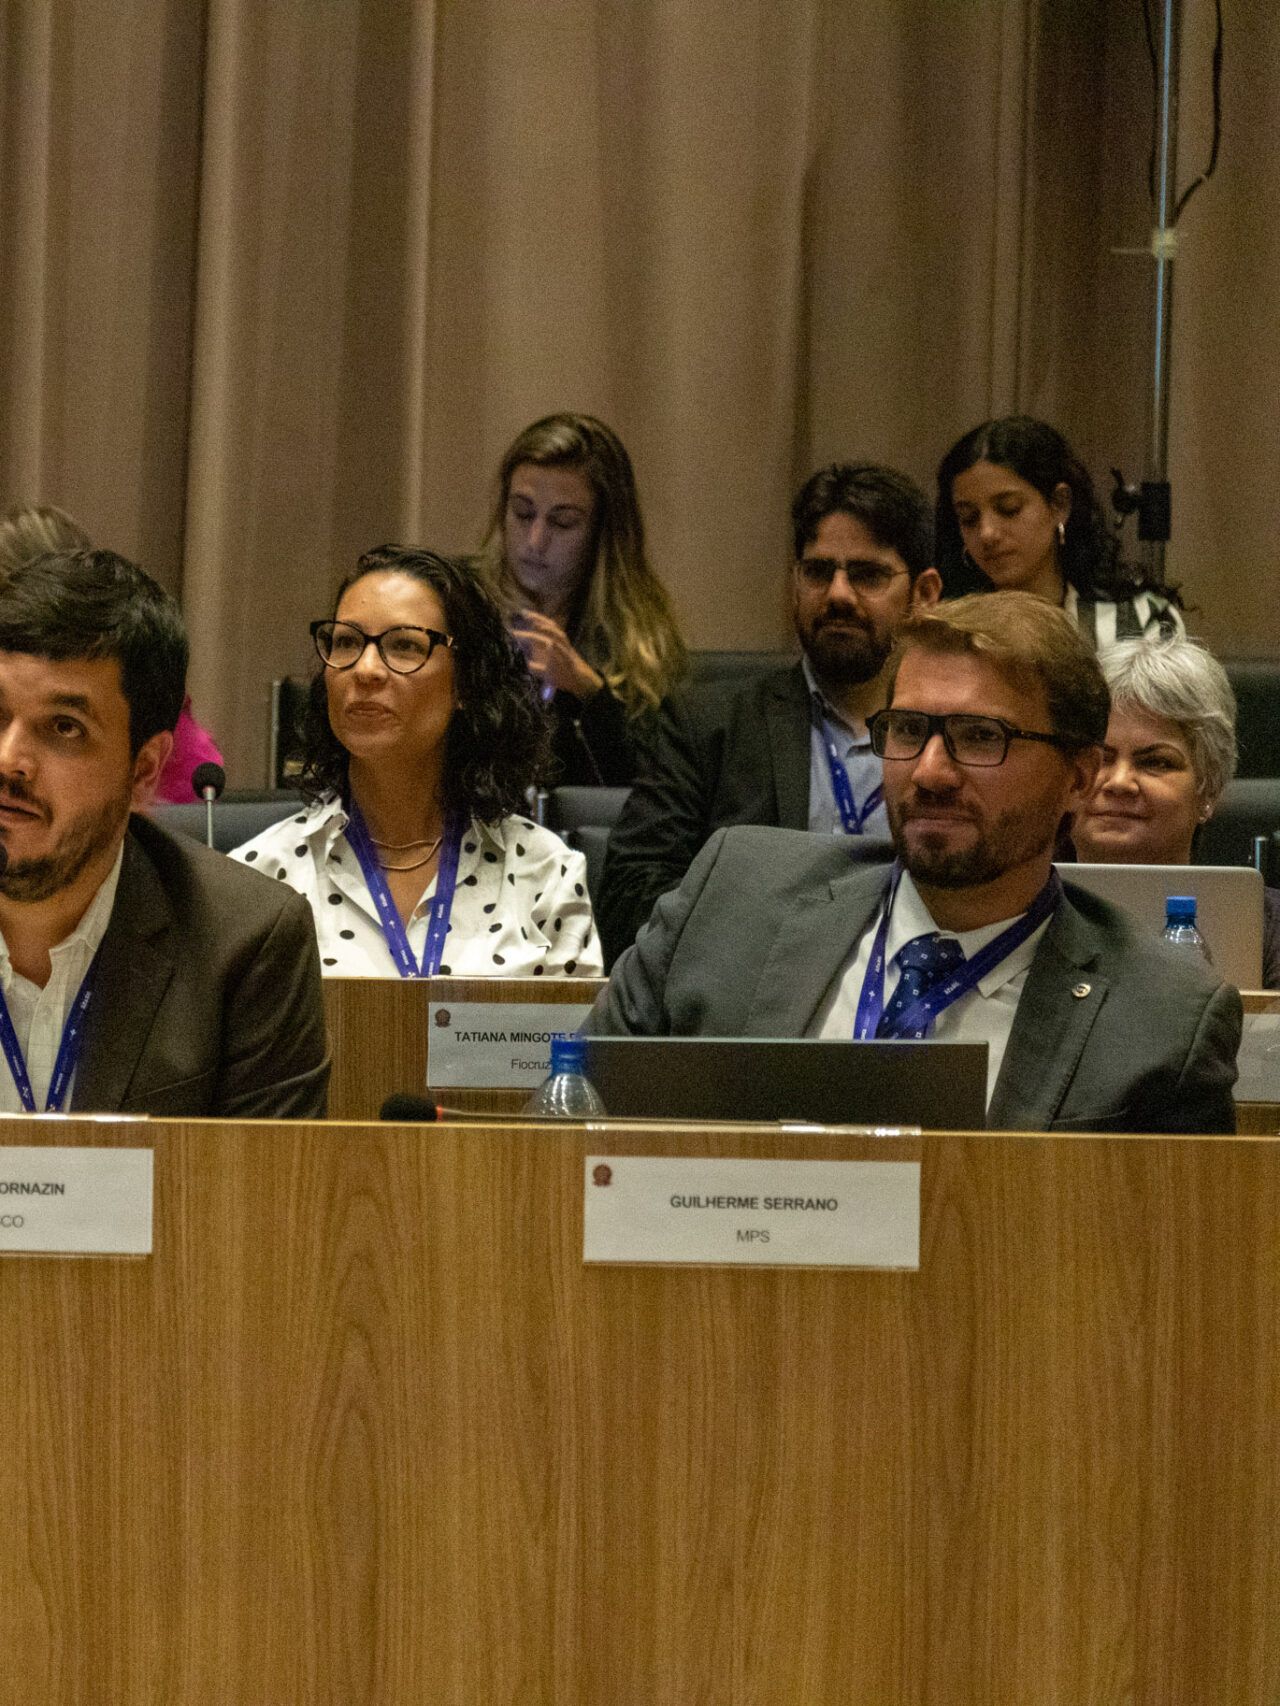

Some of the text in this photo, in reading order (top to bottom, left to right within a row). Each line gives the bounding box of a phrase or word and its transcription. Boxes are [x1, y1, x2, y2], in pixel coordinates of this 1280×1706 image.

[454, 1031, 506, 1043] TATIANA
[511, 1058, 552, 1070] Fiocruz
[670, 1195, 839, 1212] GUILHERME SERRANO
[736, 1229, 771, 1244] MPS
